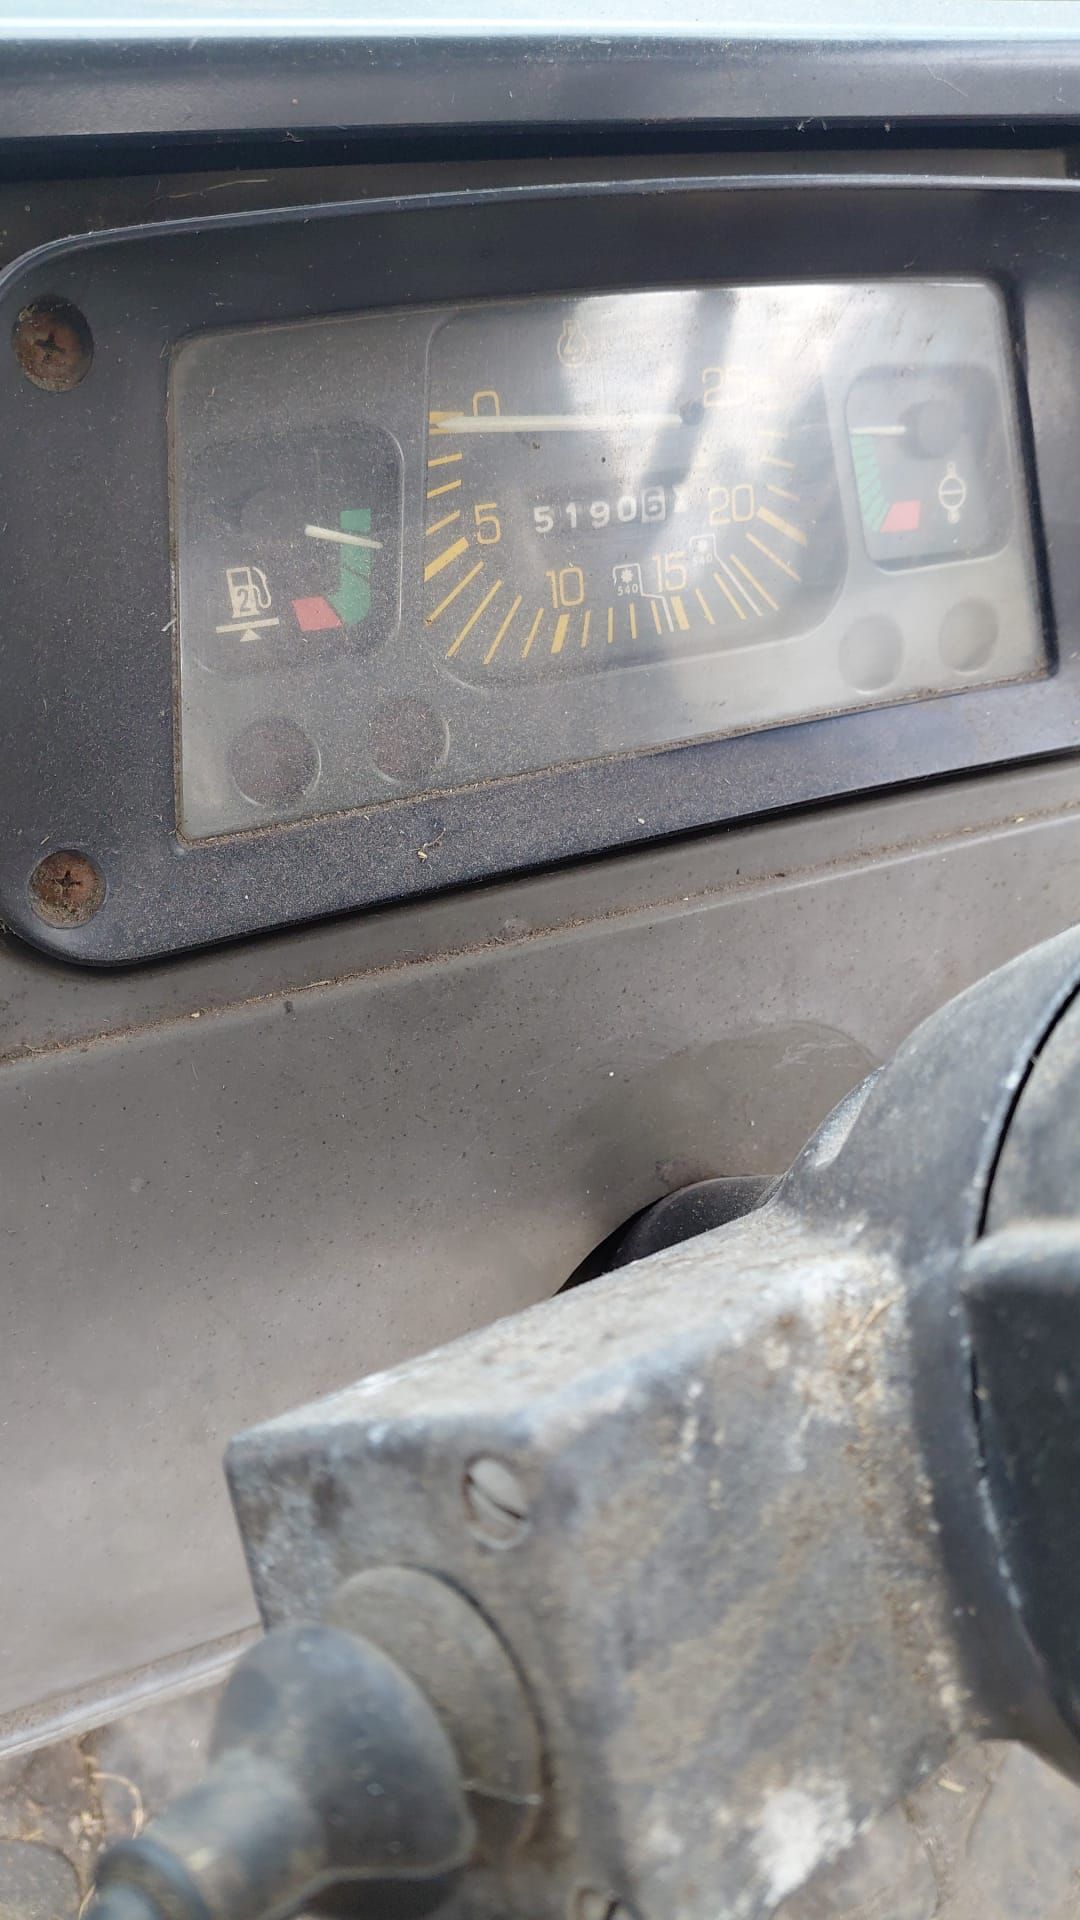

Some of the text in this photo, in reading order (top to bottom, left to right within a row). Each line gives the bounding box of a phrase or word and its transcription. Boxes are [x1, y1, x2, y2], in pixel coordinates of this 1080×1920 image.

[475, 502, 501, 544] 5
[709, 484, 754, 526] 20
[546, 566, 584, 608] 10
[617, 584, 639, 596] 540
[652, 551, 687, 592] 15
